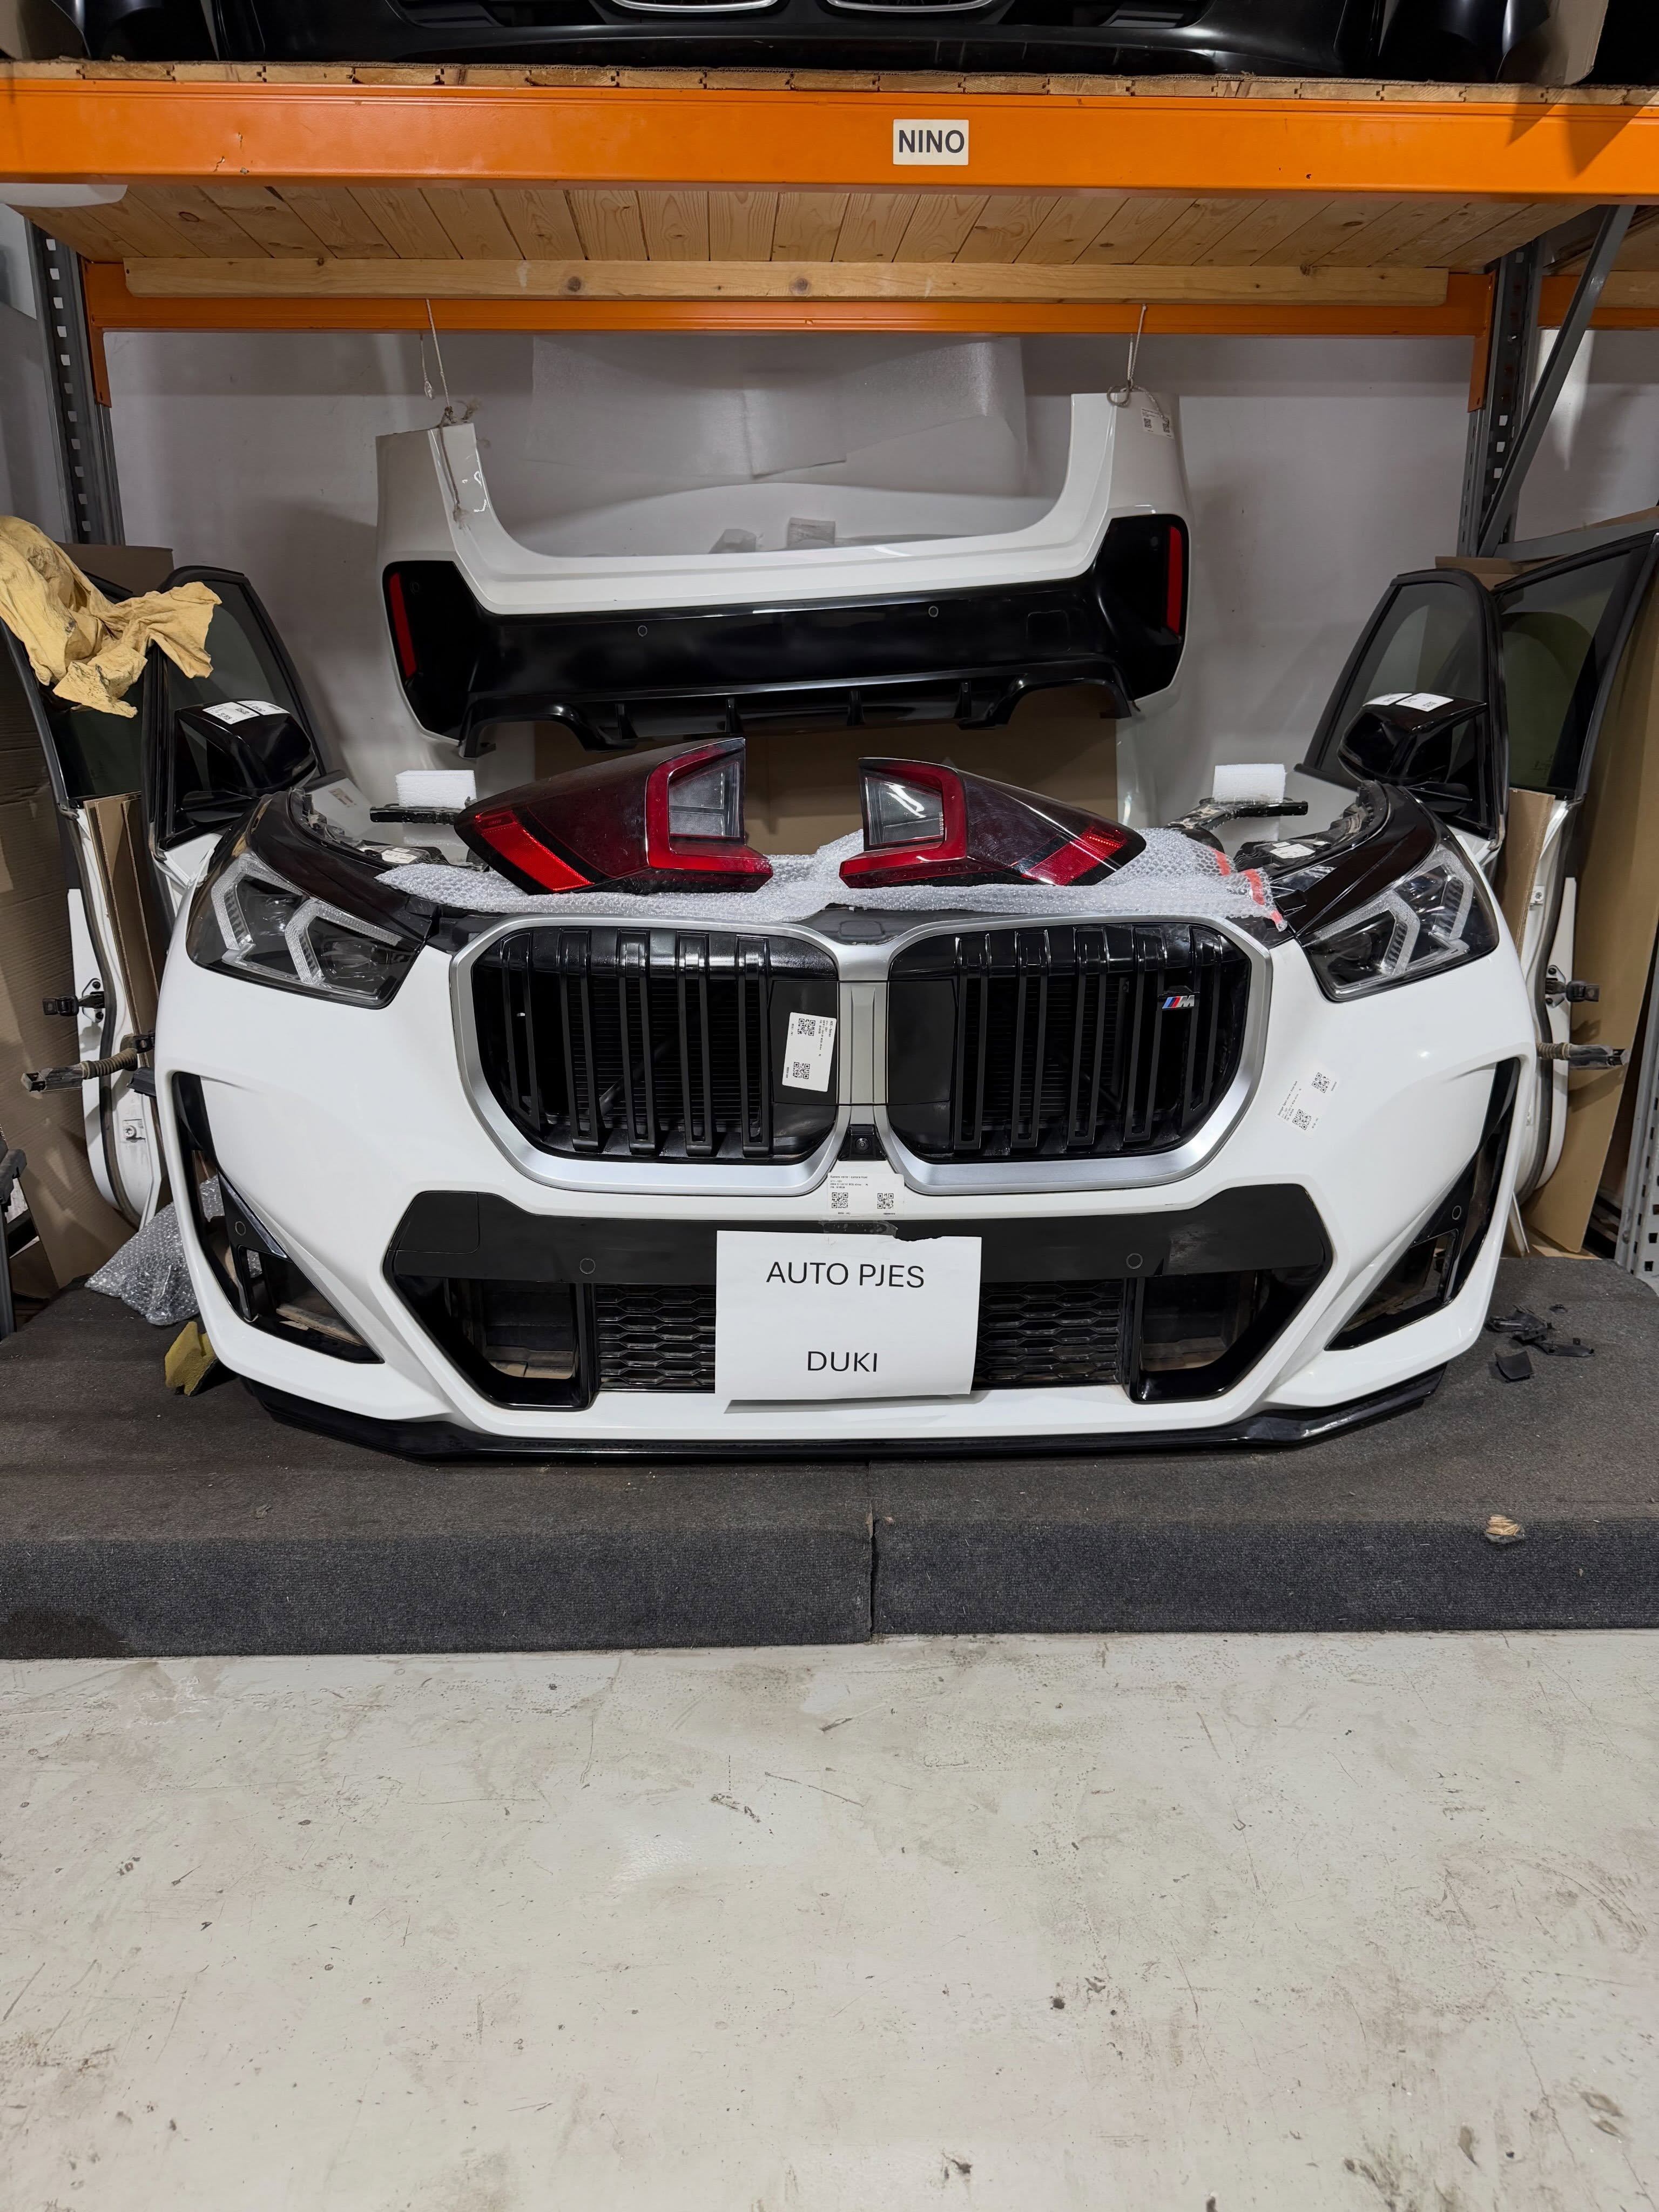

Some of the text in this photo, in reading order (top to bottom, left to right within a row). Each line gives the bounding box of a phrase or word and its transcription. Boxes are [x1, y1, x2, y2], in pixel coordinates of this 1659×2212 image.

[899, 130, 965, 153] NINO
[1175, 995, 1195, 1008] M
[766, 1262, 924, 1288] AUTO PJES
[807, 1351, 878, 1372] DUKI
